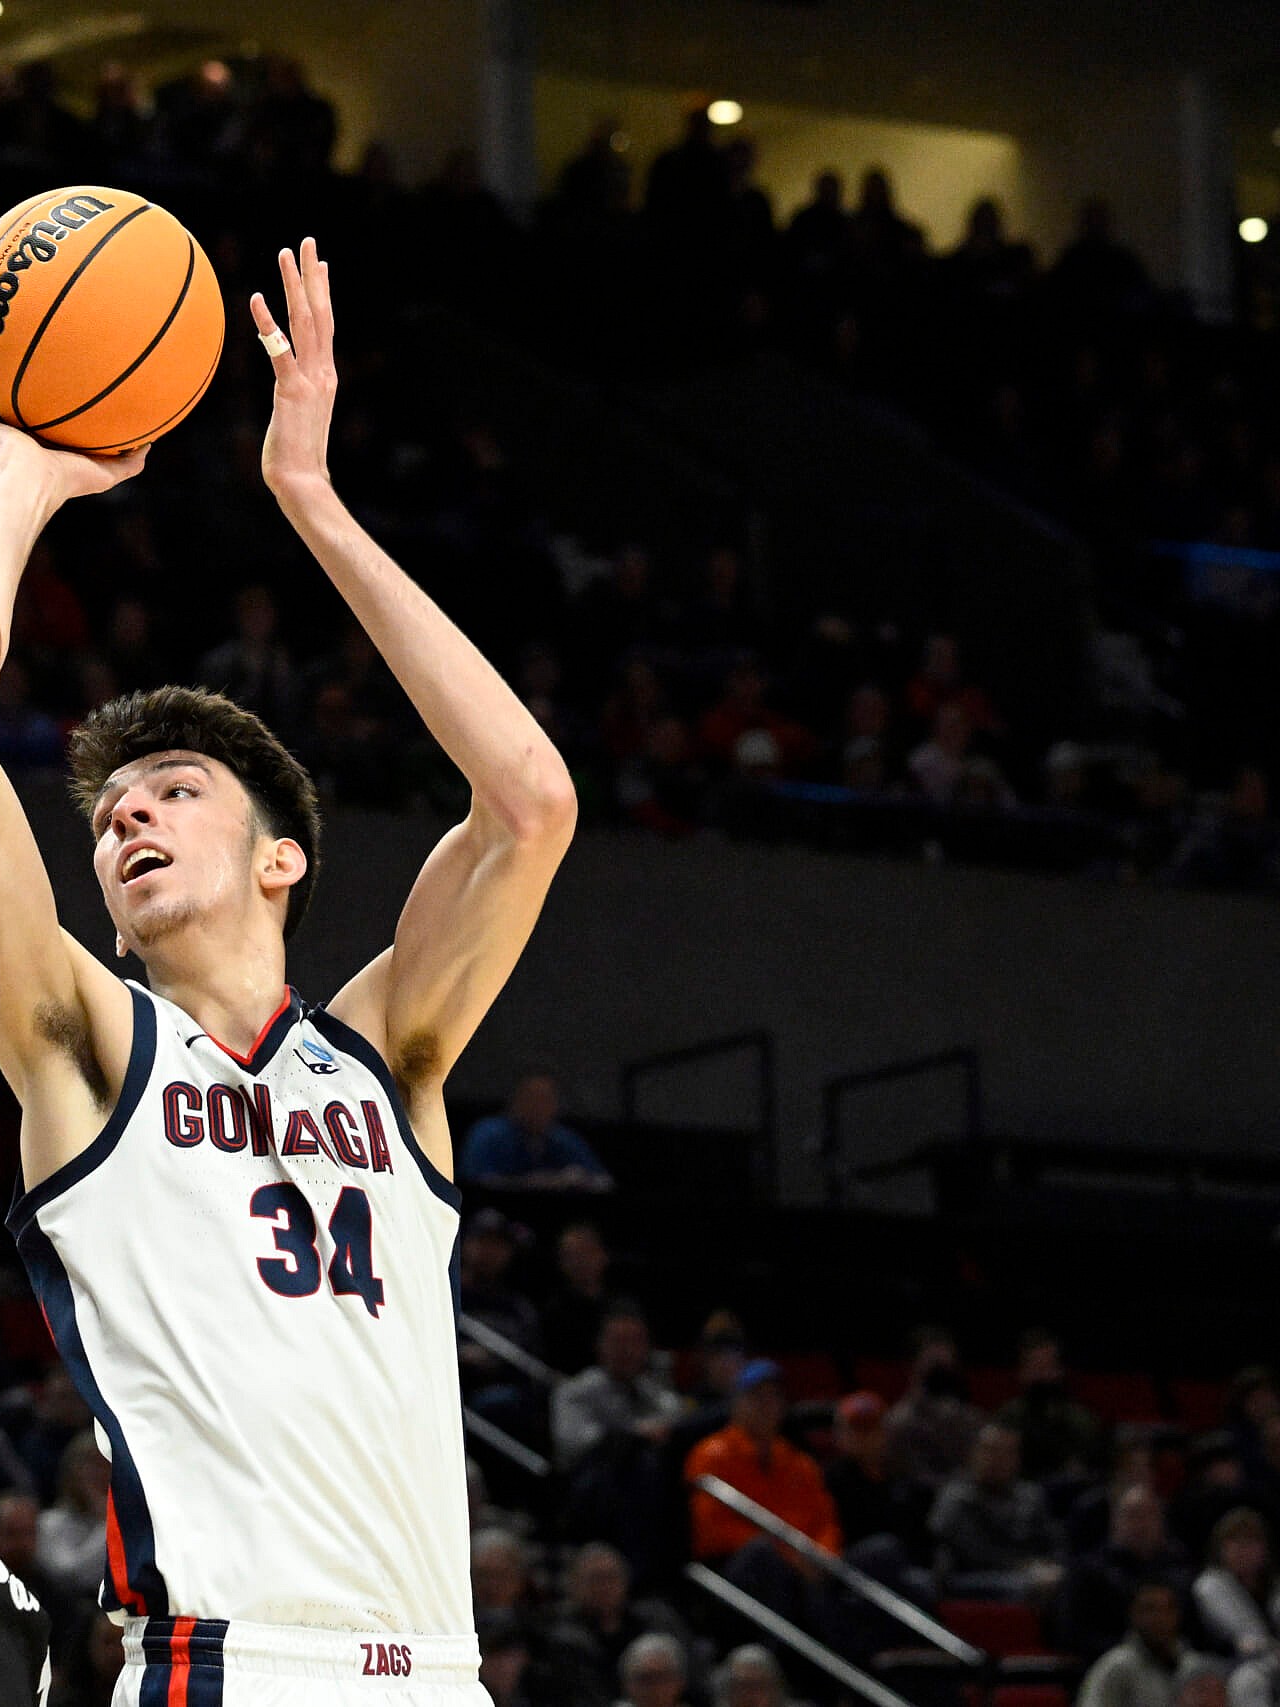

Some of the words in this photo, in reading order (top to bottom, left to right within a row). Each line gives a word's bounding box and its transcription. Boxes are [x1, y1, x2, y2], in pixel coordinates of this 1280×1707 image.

[162, 1081, 394, 1175] GONAGA
[249, 1181, 385, 1319] 34
[360, 1643, 412, 1677] ZAGS
